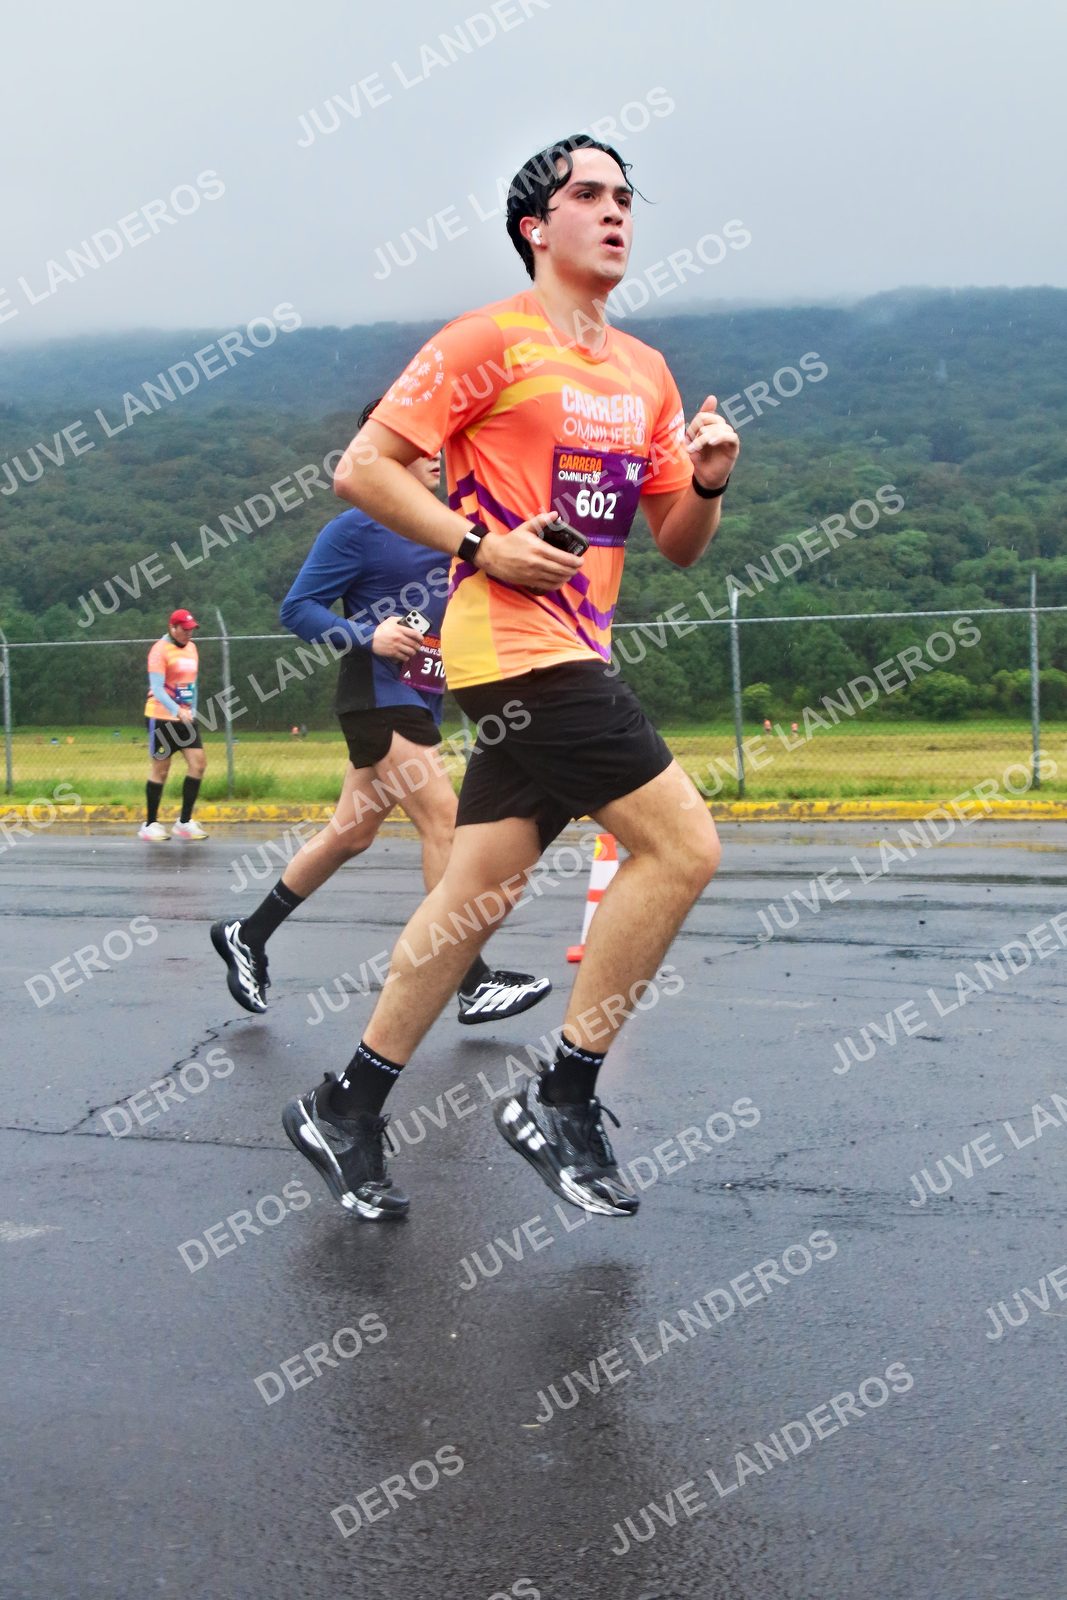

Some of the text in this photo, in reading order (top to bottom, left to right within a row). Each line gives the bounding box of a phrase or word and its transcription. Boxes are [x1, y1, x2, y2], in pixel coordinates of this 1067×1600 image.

[562, 384, 646, 423] CARRERA
[562, 417, 632, 445] OMNILIFE
[559, 453, 602, 471] CARRERA
[558, 470, 592, 484] OMNILIFE
[576, 489, 617, 519] 602
